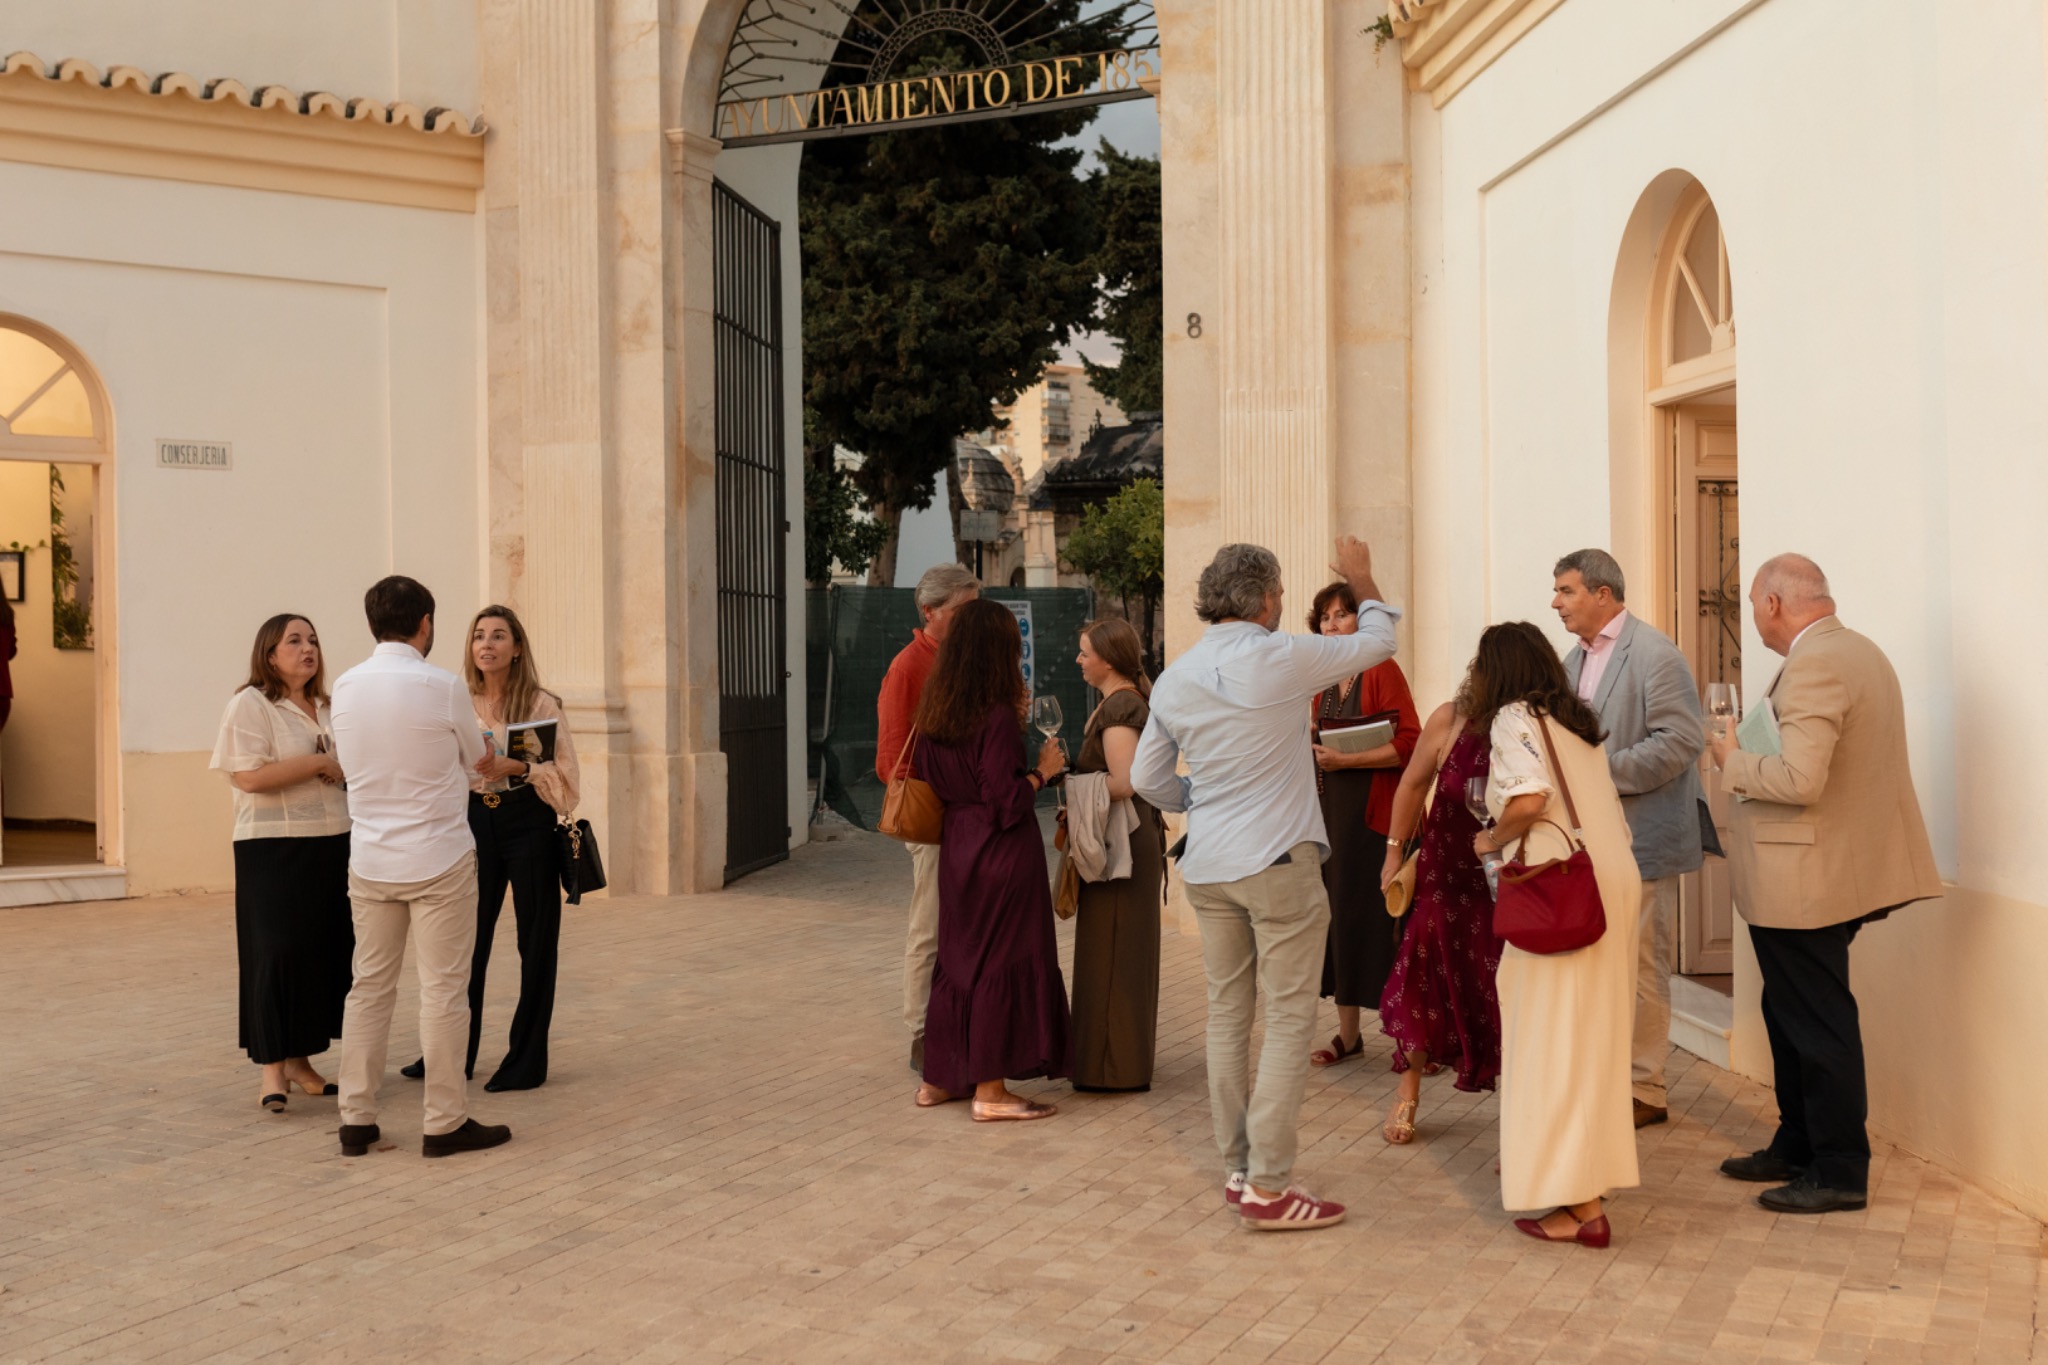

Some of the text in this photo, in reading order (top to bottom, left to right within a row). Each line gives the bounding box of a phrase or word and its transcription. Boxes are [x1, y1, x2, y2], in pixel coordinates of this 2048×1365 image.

[718, 48, 1161, 137] AYUNTAMIENTO DE 185
[1187, 312, 1202, 339] 8
[161, 443, 227, 465] CONSERJERIA
